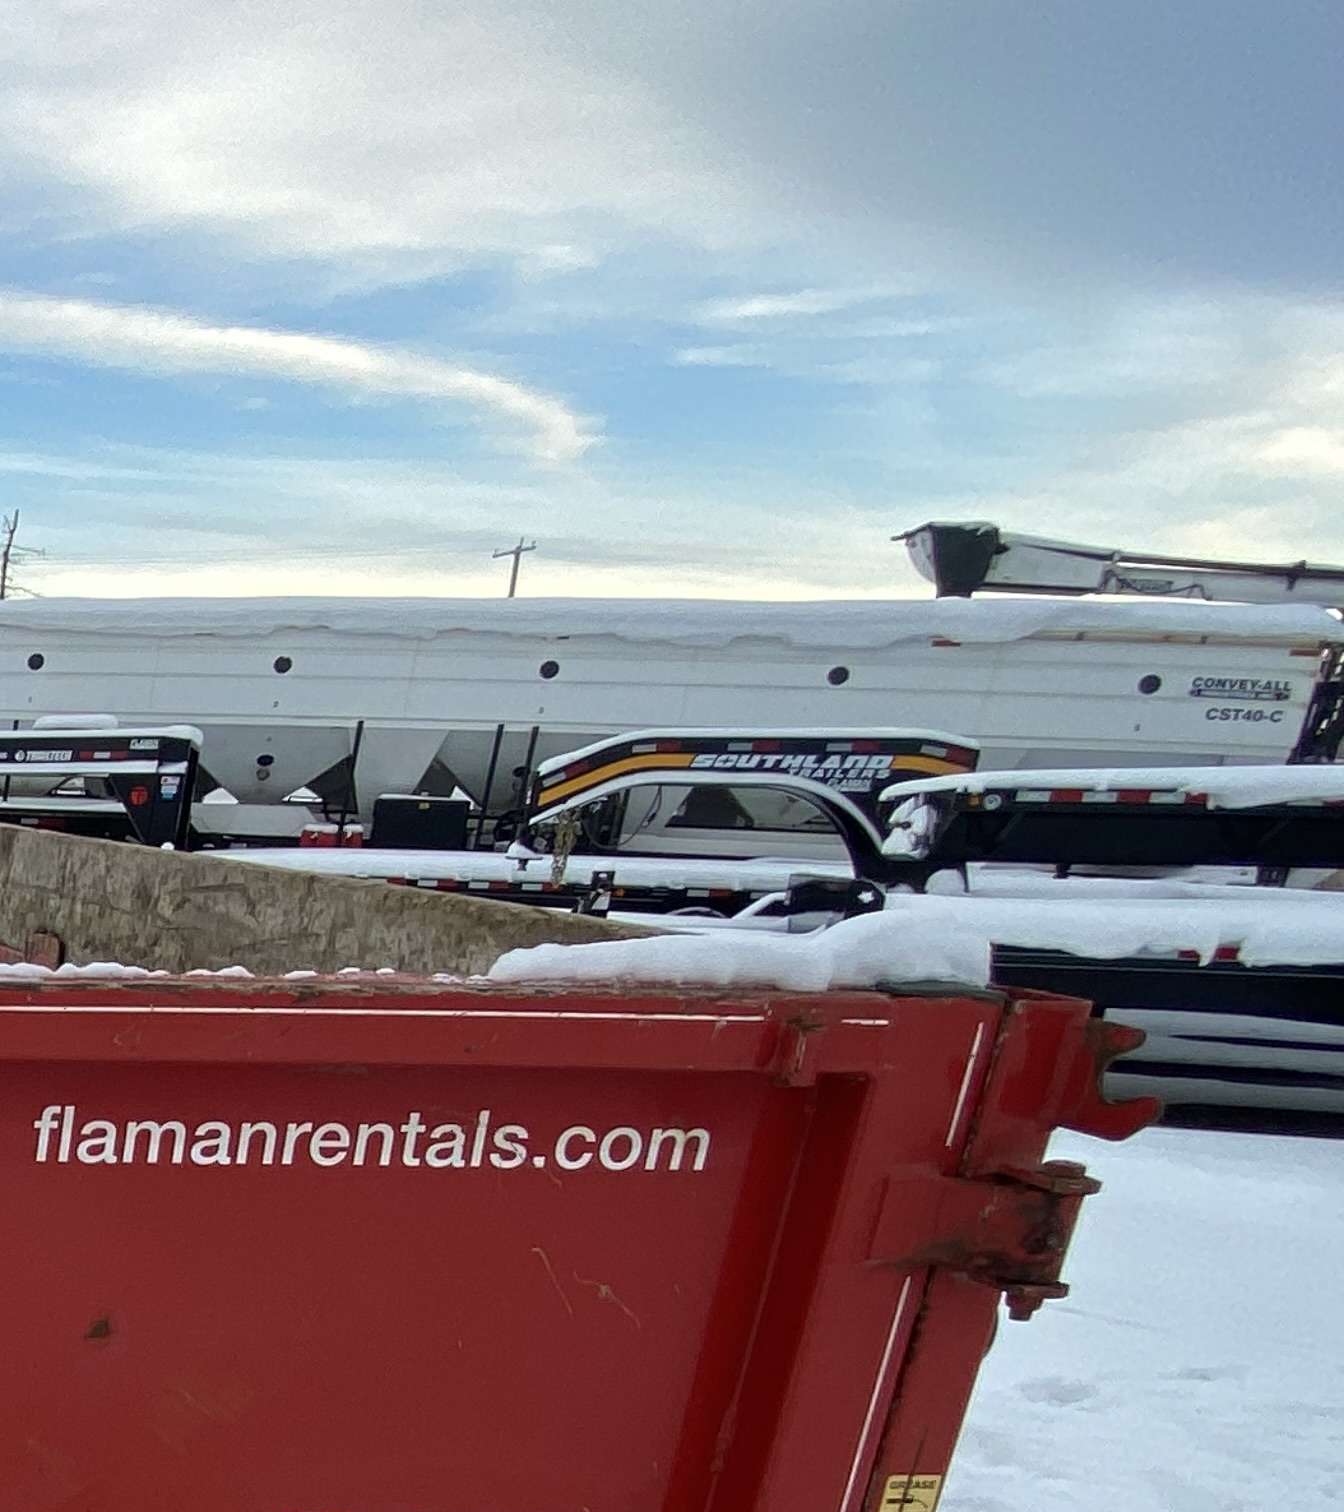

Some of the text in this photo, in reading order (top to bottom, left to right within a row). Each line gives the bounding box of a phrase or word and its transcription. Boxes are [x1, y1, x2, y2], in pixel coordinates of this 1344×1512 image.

[1192, 677, 1292, 692] CONVEY-ALL
[1205, 707, 1284, 722] CST40-C
[691, 754, 894, 769] SOUTHLAND
[789, 768, 891, 779] TRAILERS
[33, 1105, 712, 1171] flamanrentals.com
